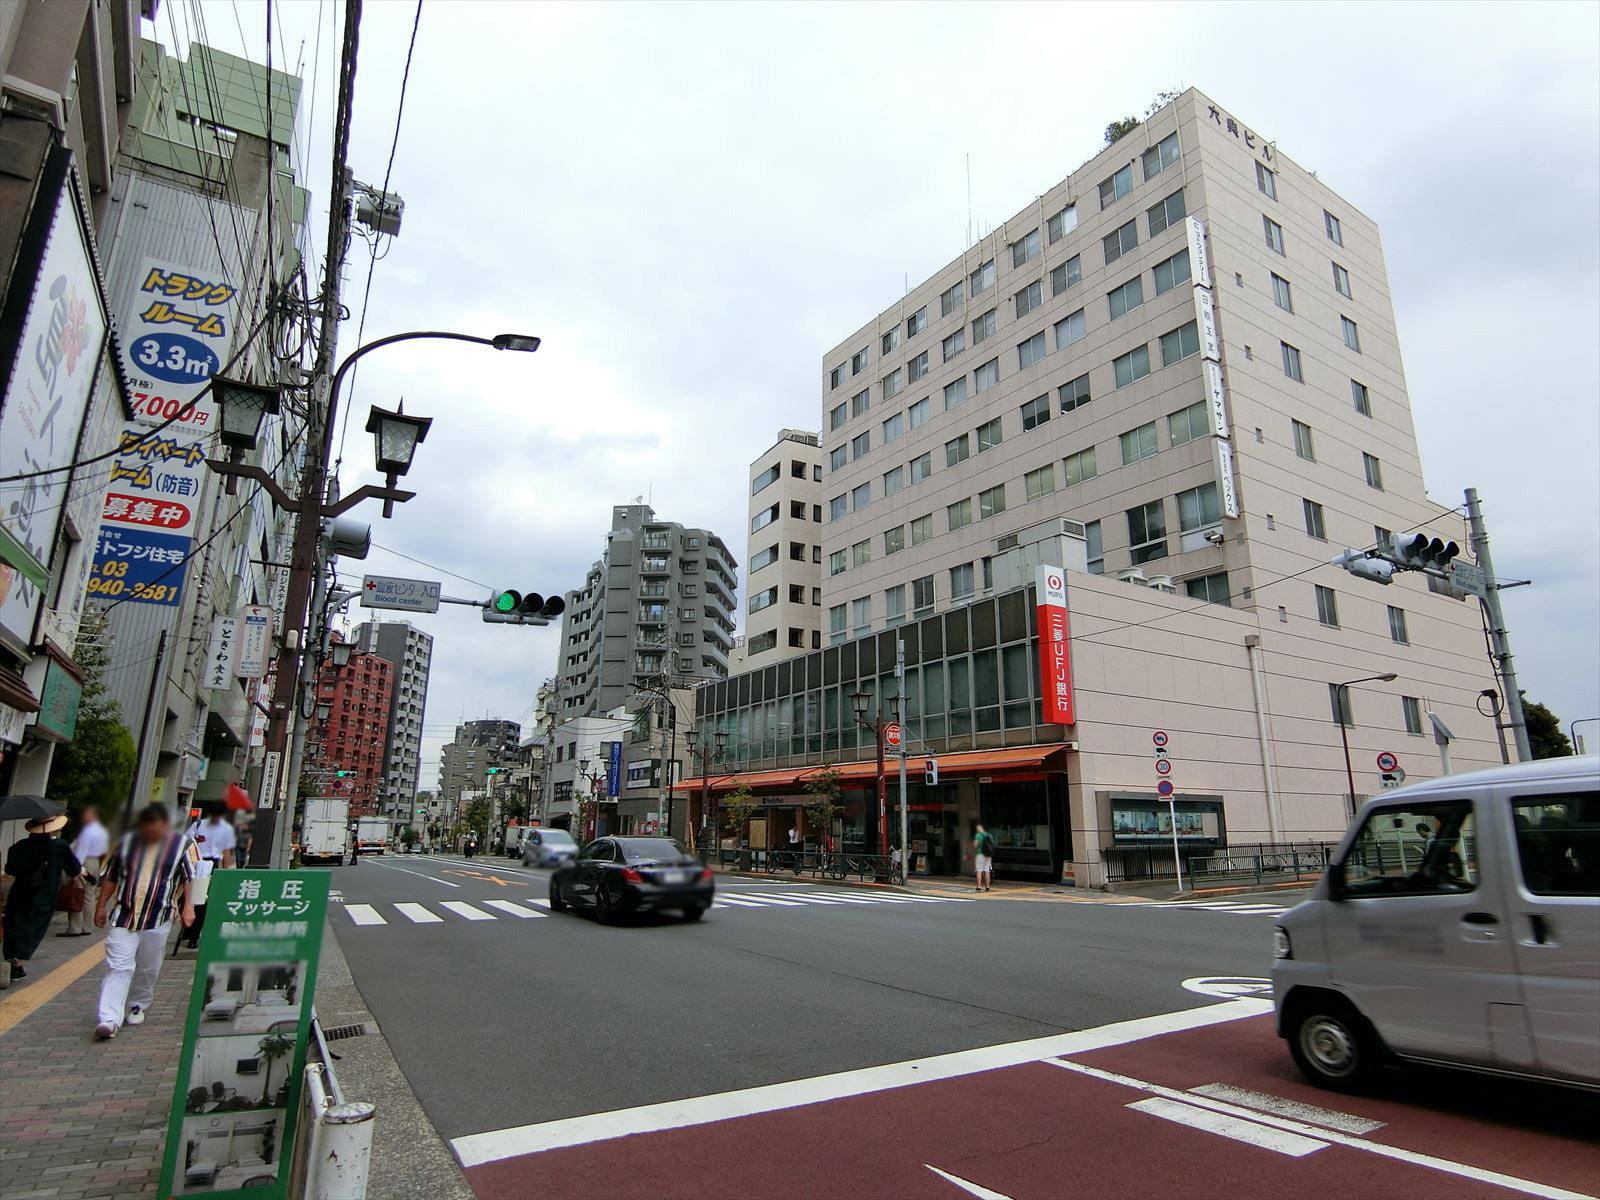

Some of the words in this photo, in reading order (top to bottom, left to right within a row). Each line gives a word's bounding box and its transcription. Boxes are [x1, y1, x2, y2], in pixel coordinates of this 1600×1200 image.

[141, 267, 238, 305] トランク
[139, 301, 226, 337] ルーム
[129, 391, 209, 426] 7,000円
[119, 430, 206, 468] ライベート
[156, 473, 200, 497] (防音)
[104, 496, 184, 525] 募集中
[102, 560, 129, 577] 03
[375, 594, 397, 604] Blood
[398, 597, 423, 606] center
[1048, 590, 1063, 599] MUFG
[212, 628, 232, 686] ときわ食堂
[1052, 613, 1068, 711] 三菱UFJ銀行
[226, 900, 311, 916] マッサージ
